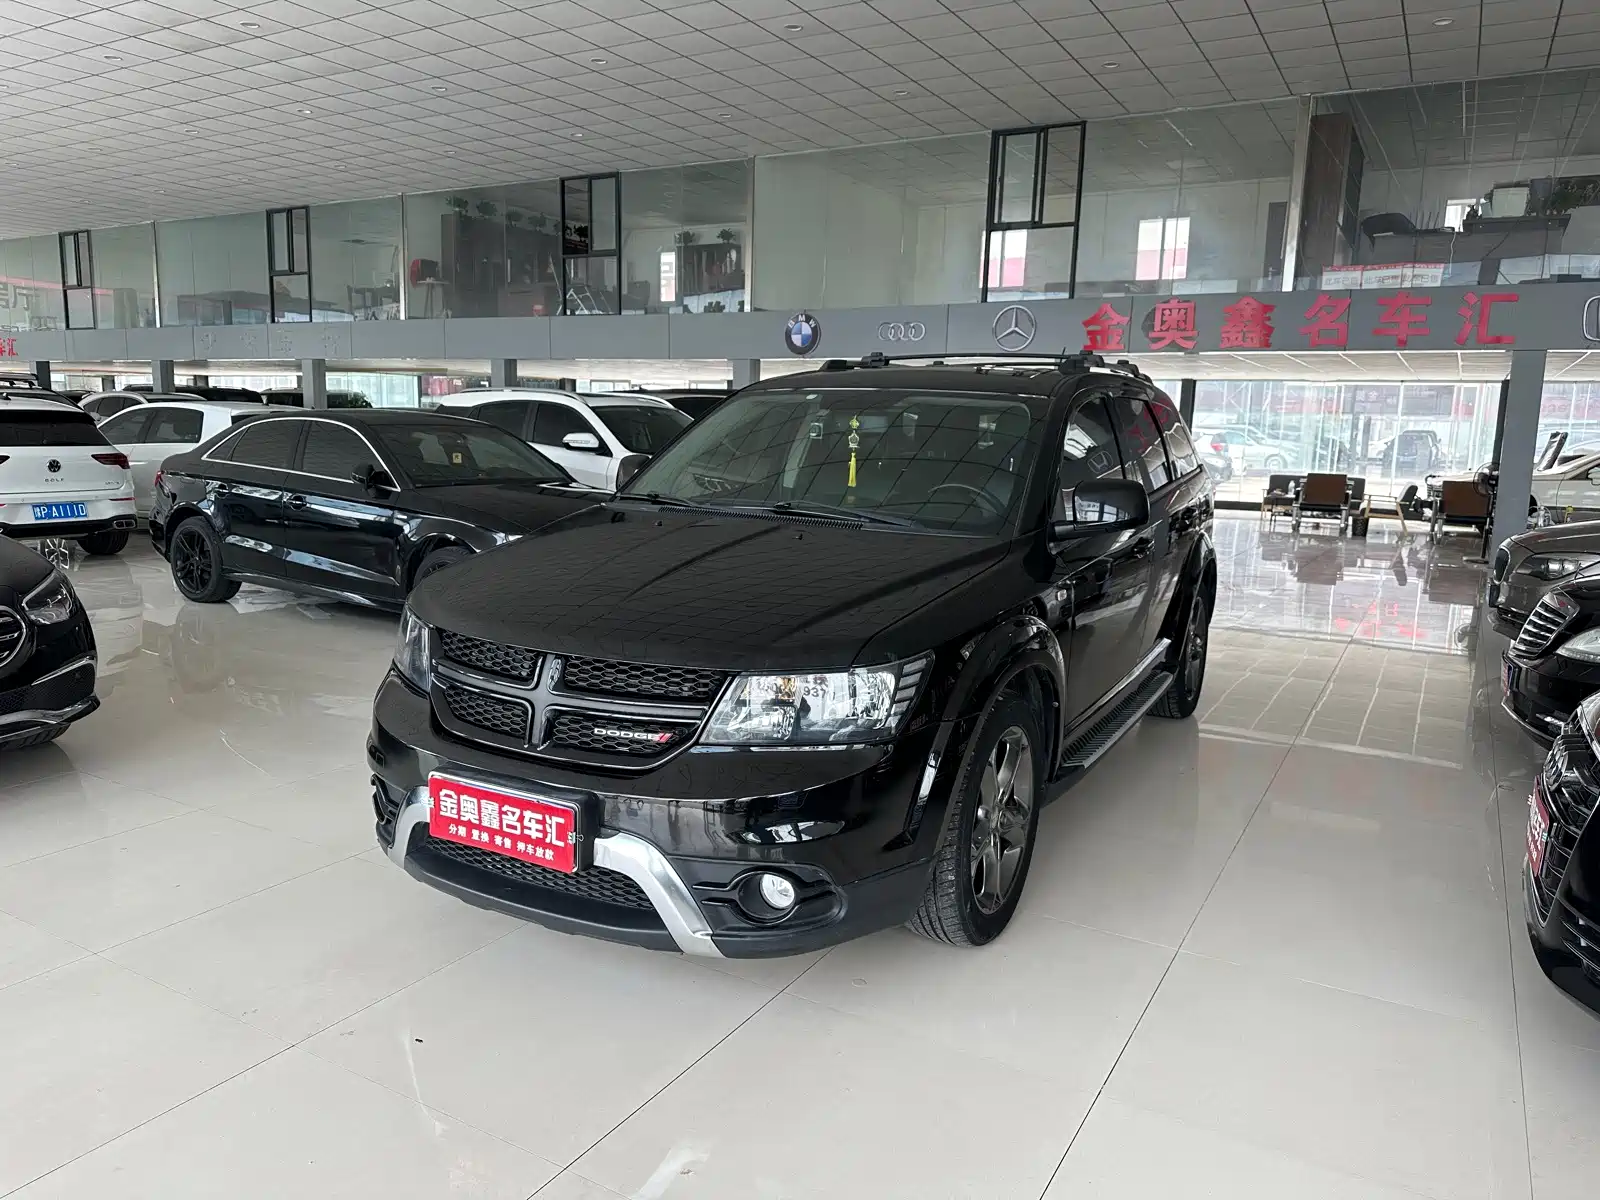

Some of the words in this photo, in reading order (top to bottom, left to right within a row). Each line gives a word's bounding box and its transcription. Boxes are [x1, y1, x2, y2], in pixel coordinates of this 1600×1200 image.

[1082, 292, 1520, 351] 金奥鑫名车汇
[594, 727, 659, 741] DODGE
[439, 788, 566, 848] 金奥鑫名车汇
[448, 823, 467, 838] 分期
[471, 829, 490, 843] 置换
